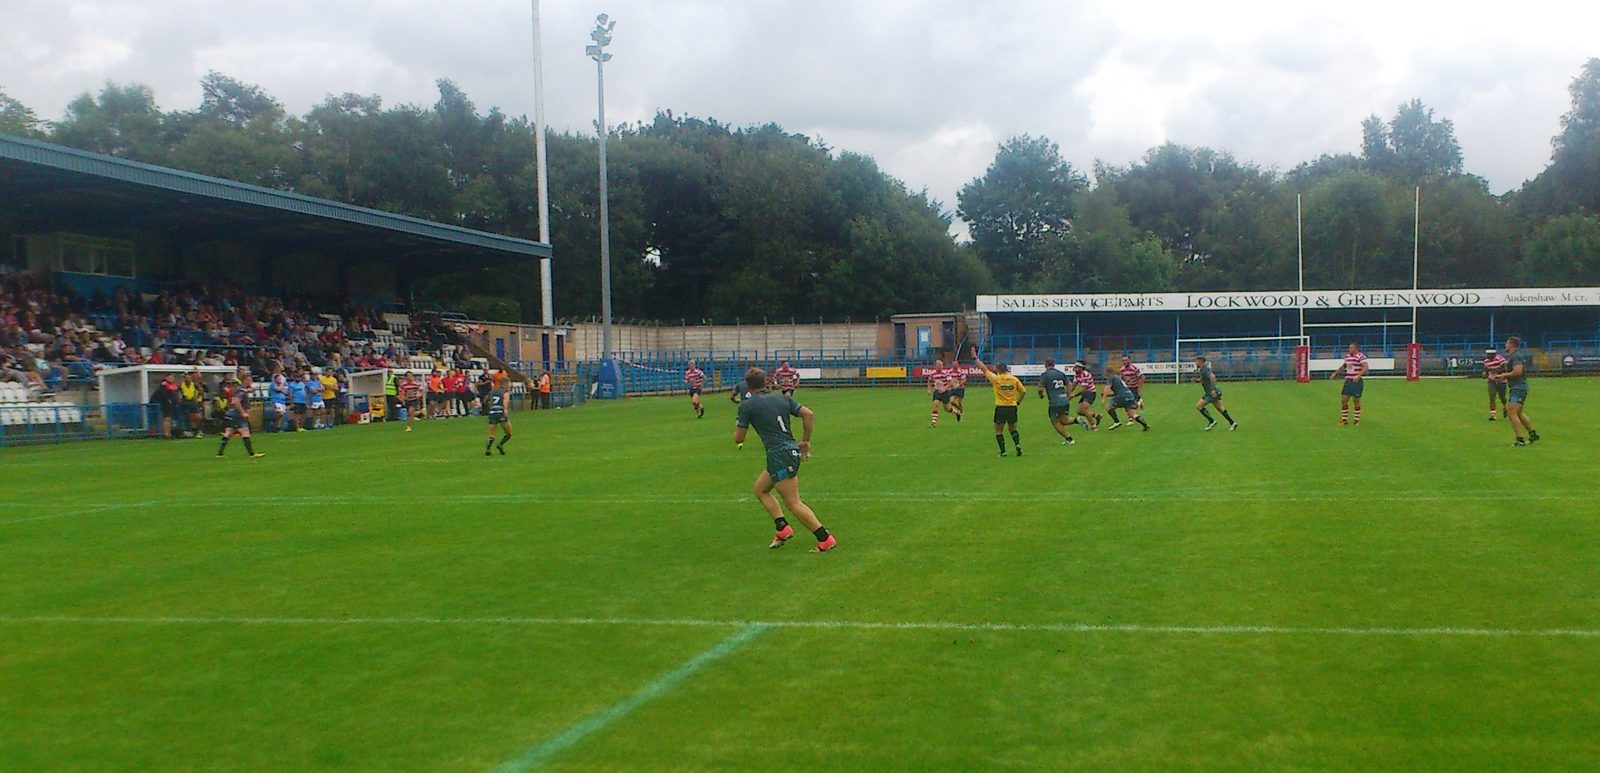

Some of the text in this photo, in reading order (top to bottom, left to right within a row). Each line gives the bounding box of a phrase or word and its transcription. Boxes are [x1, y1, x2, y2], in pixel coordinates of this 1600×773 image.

[1002, 298, 1049, 309] SALES
[1187, 291, 1481, 308] LOCKWOOD & GREENWOOD
[492, 396, 500, 404] 7
[776, 415, 788, 433] 1
